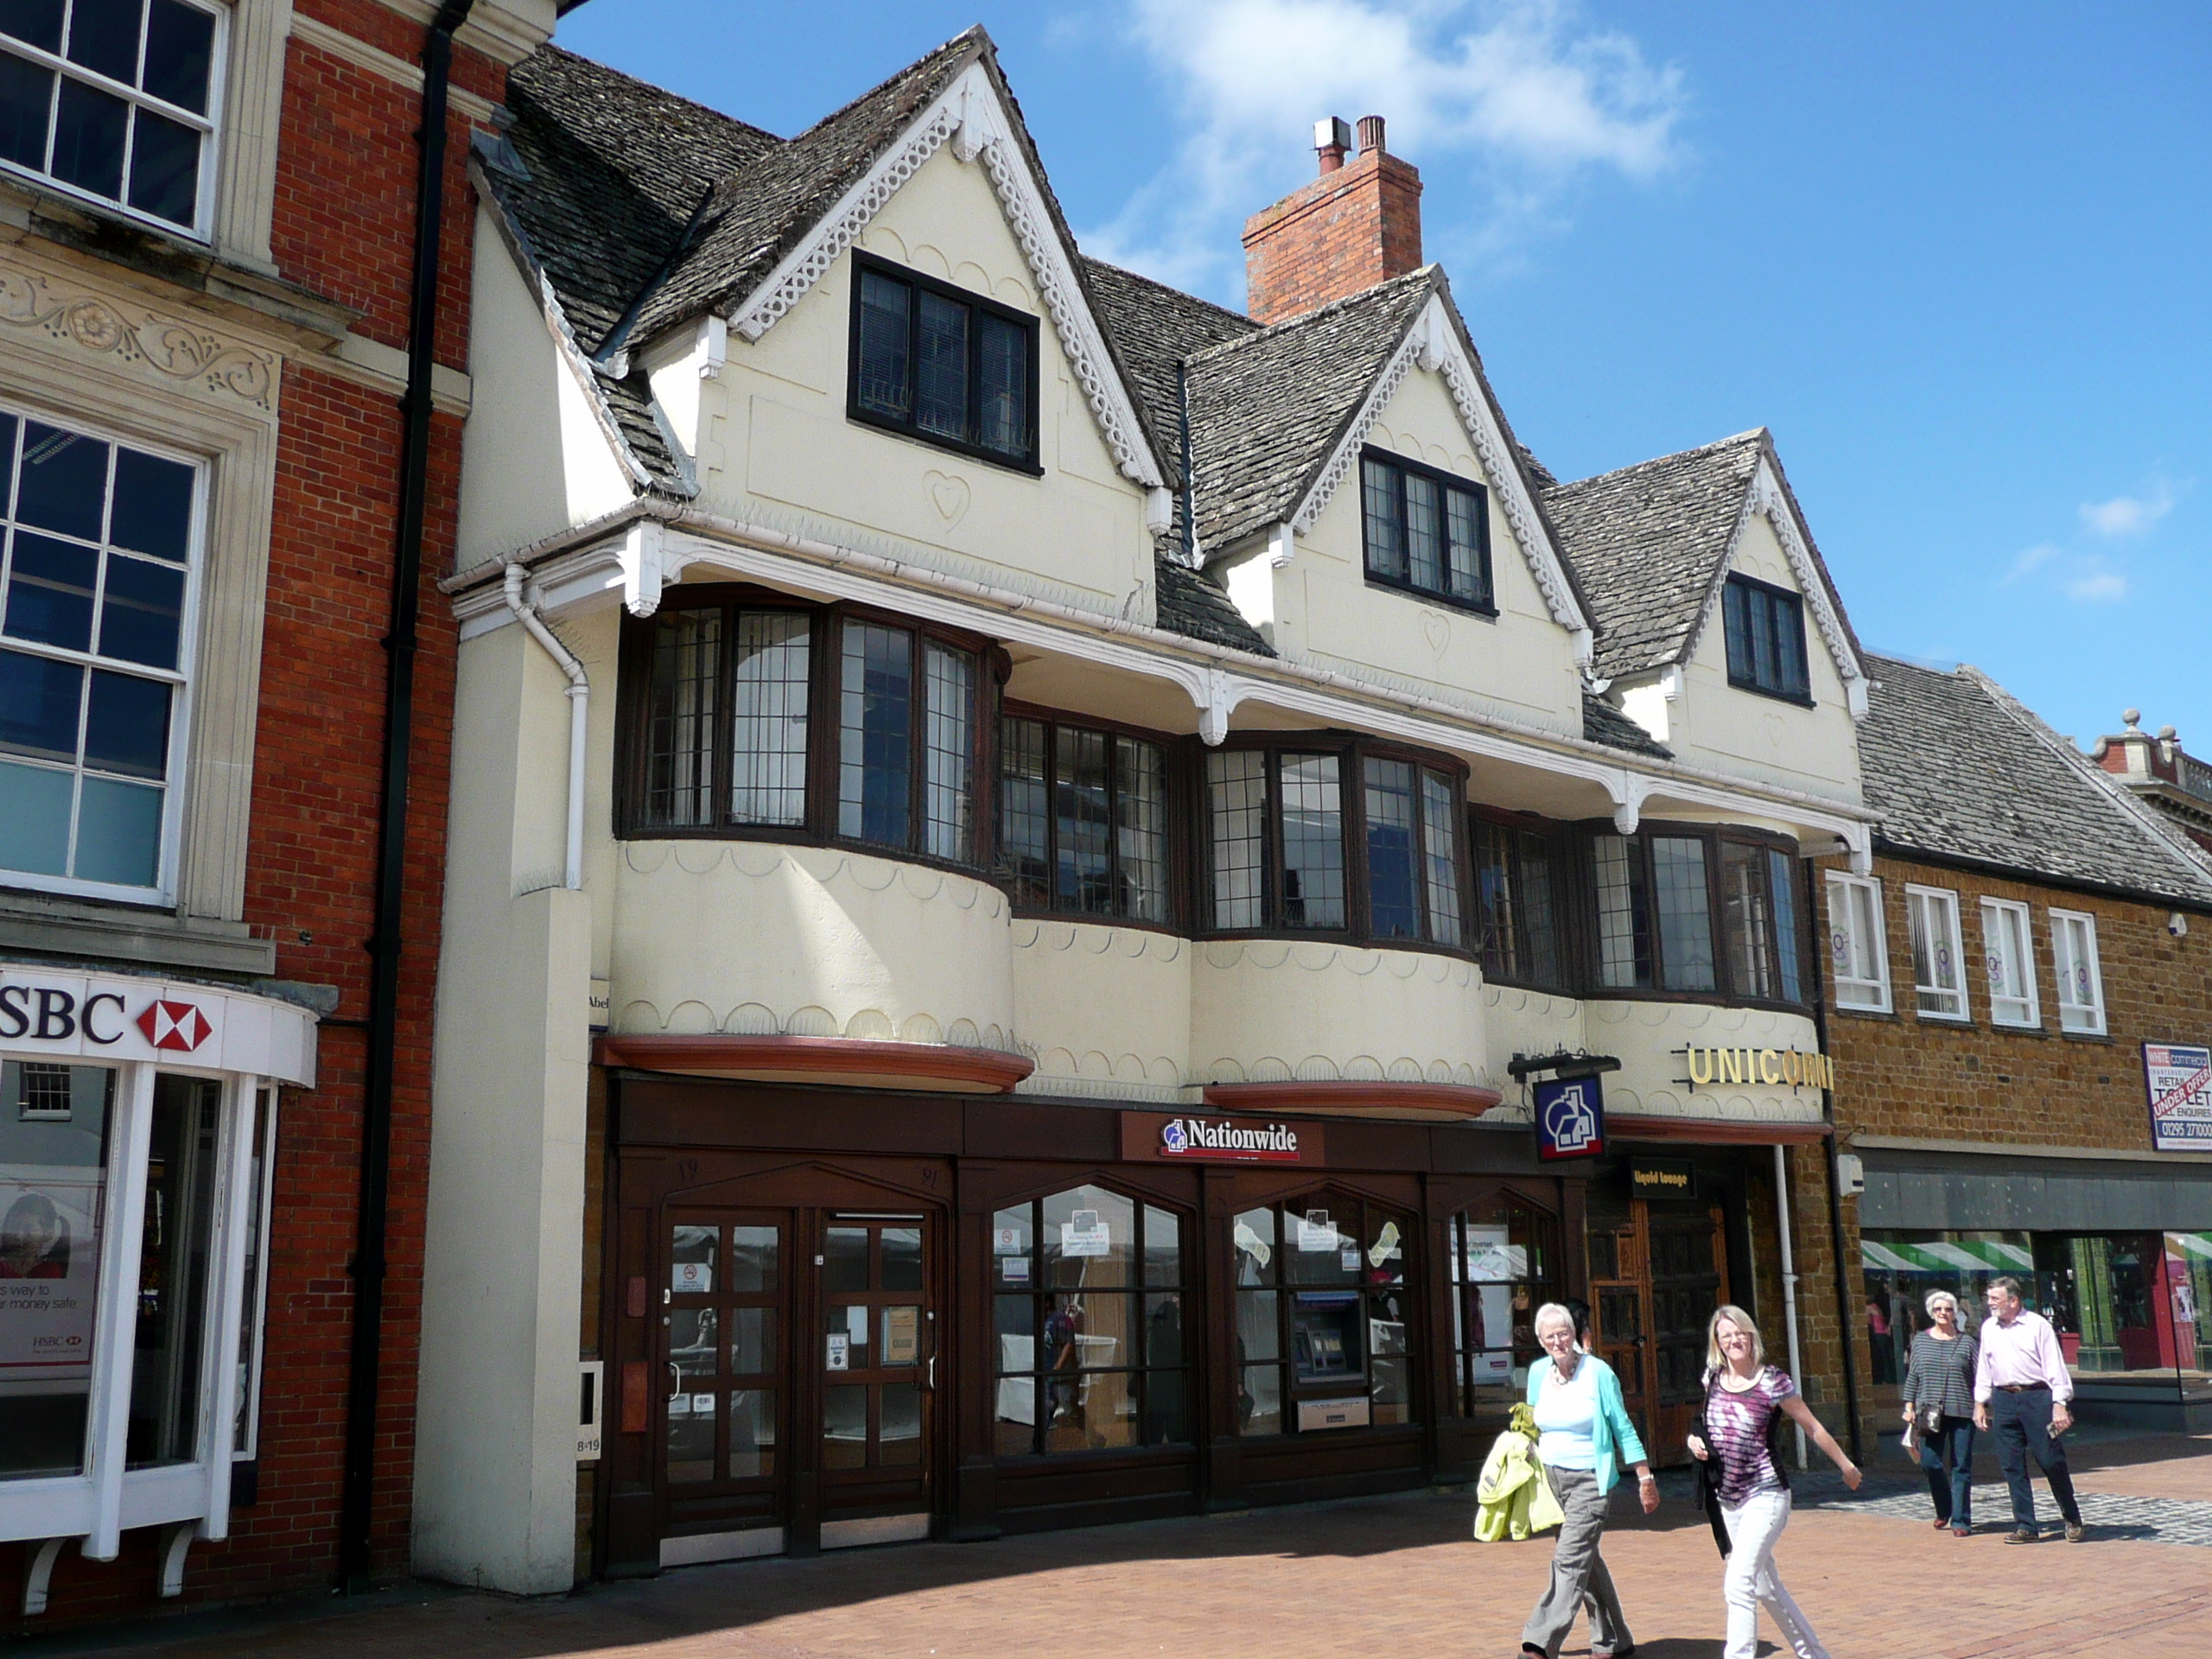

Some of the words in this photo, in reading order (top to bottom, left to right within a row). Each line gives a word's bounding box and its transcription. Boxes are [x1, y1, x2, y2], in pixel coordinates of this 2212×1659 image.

[2148, 1051, 2171, 1065] WHITE
[2153, 1087, 2187, 1116] UNDER
[2186, 1068, 2210, 1094] OFFER
[1187, 1119, 1298, 1152] Nationwide
[2162, 1122, 2185, 1137] 01295
[2186, 1122, 2212, 1138] 271000
[10, 1286, 35, 1298] way
[38, 1284, 50, 1295] to
[10, 1299, 51, 1311] money
[52, 1296, 77, 1309] safe
[33, 1336, 64, 1347] HSBC
